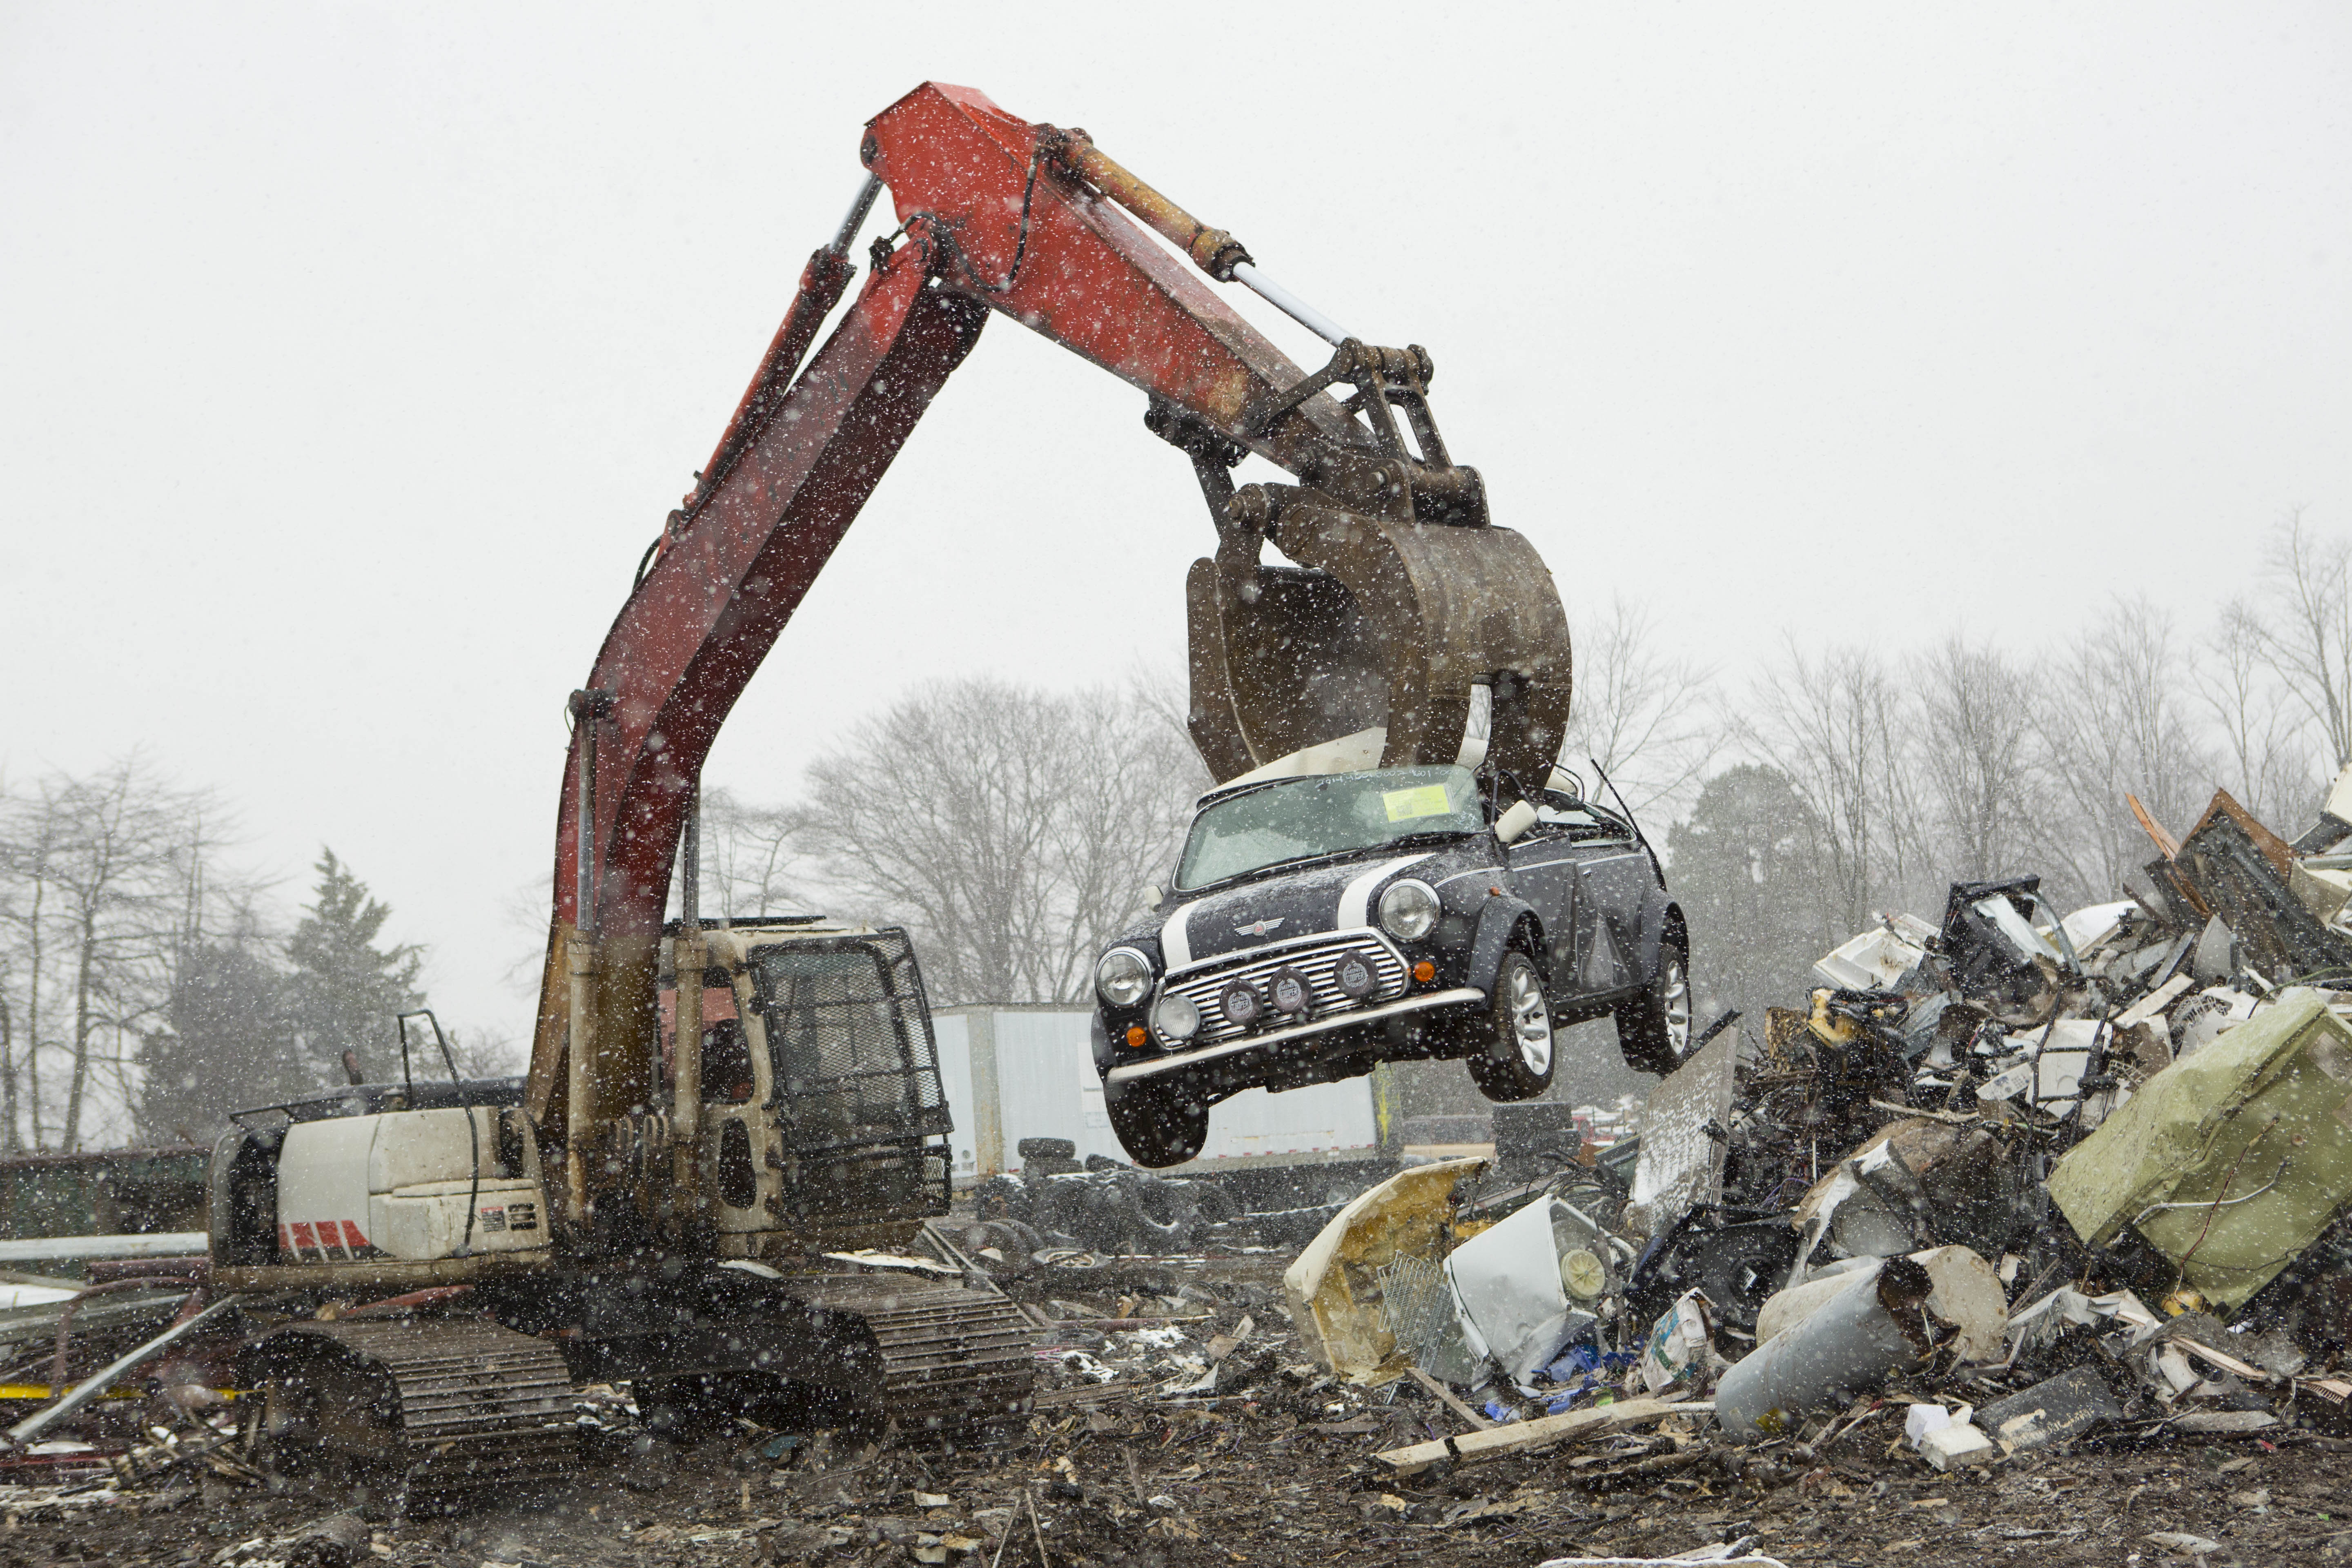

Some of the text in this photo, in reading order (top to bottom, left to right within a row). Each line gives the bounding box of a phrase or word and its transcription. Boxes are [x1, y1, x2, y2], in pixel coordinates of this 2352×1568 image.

[1347, 966, 1361, 974] MINI
[1347, 972, 1364, 982] COOPER
[1281, 982, 1294, 991] MINI
[1281, 987, 1298, 998] COOPER
[1232, 996, 1246, 1004] MINI
[1232, 1000, 1249, 1010] COOPER
